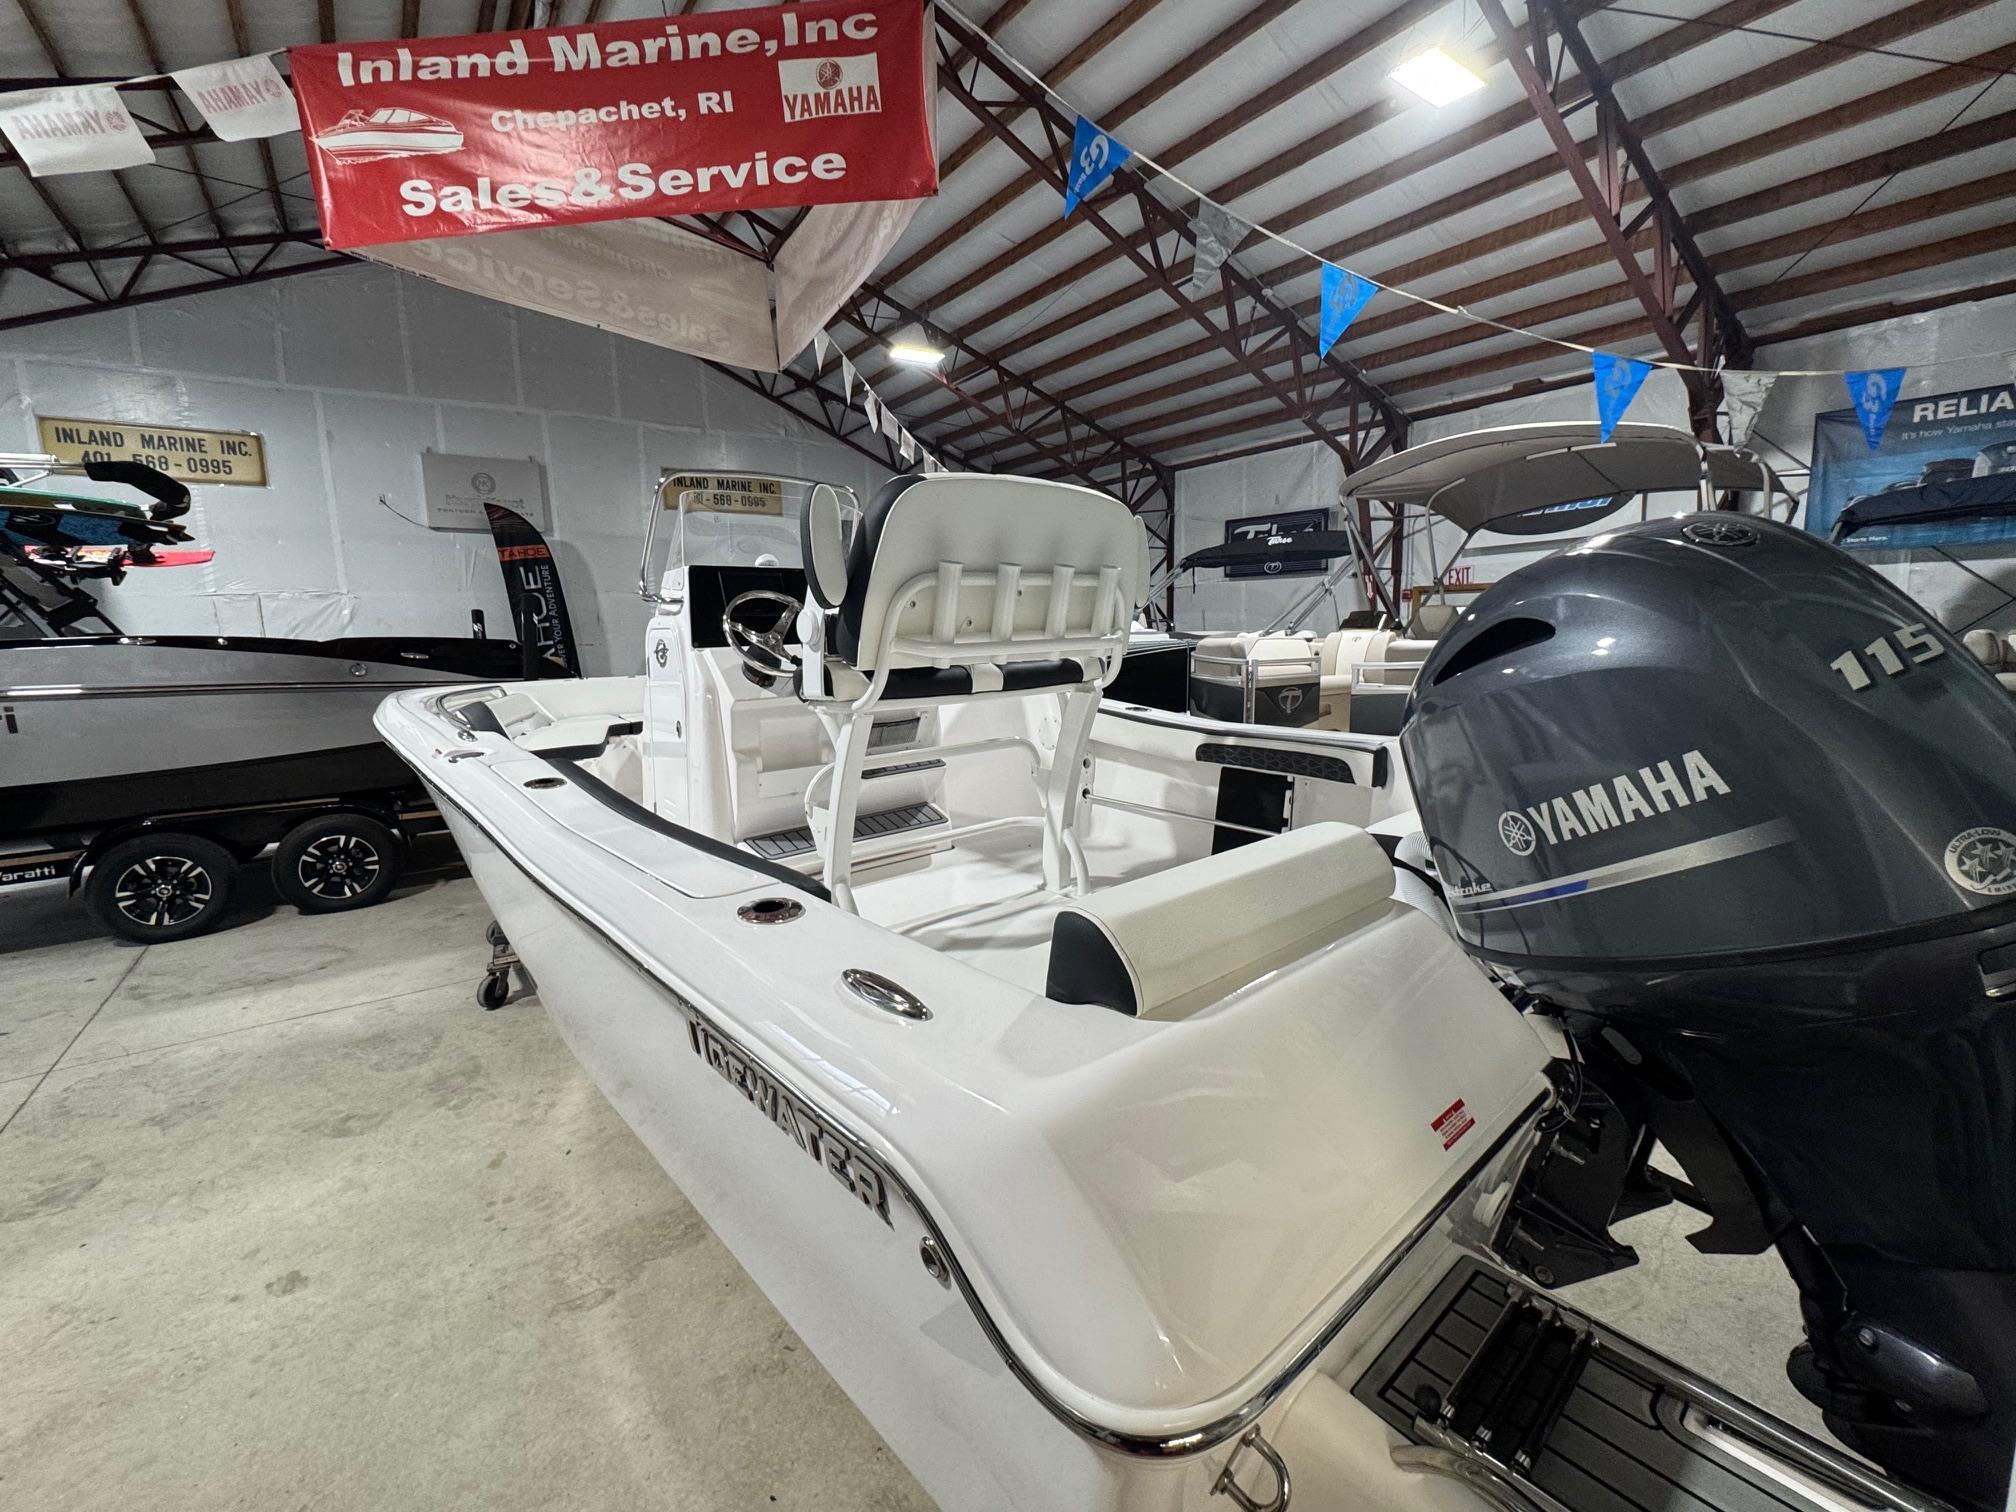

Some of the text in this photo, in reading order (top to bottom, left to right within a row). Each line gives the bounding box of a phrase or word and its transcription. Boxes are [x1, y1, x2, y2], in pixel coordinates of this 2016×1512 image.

[338, 38, 530, 87] Inland
[490, 90, 734, 133] Chepachet, RI
[784, 85, 881, 120] YAMAHA
[55, 427, 253, 457] INLAND MARINE INC.
[1946, 422, 1993, 435] Yamaha
[673, 476, 709, 489] INLAND
[717, 478, 753, 493] MARINE
[499, 547, 548, 560] TAHOE
[541, 564, 558, 617] ADVENTURE
[1448, 567, 1471, 585] EXIT
[1829, 622, 1945, 691] 115
[1526, 749, 1732, 845] YAMAHA
